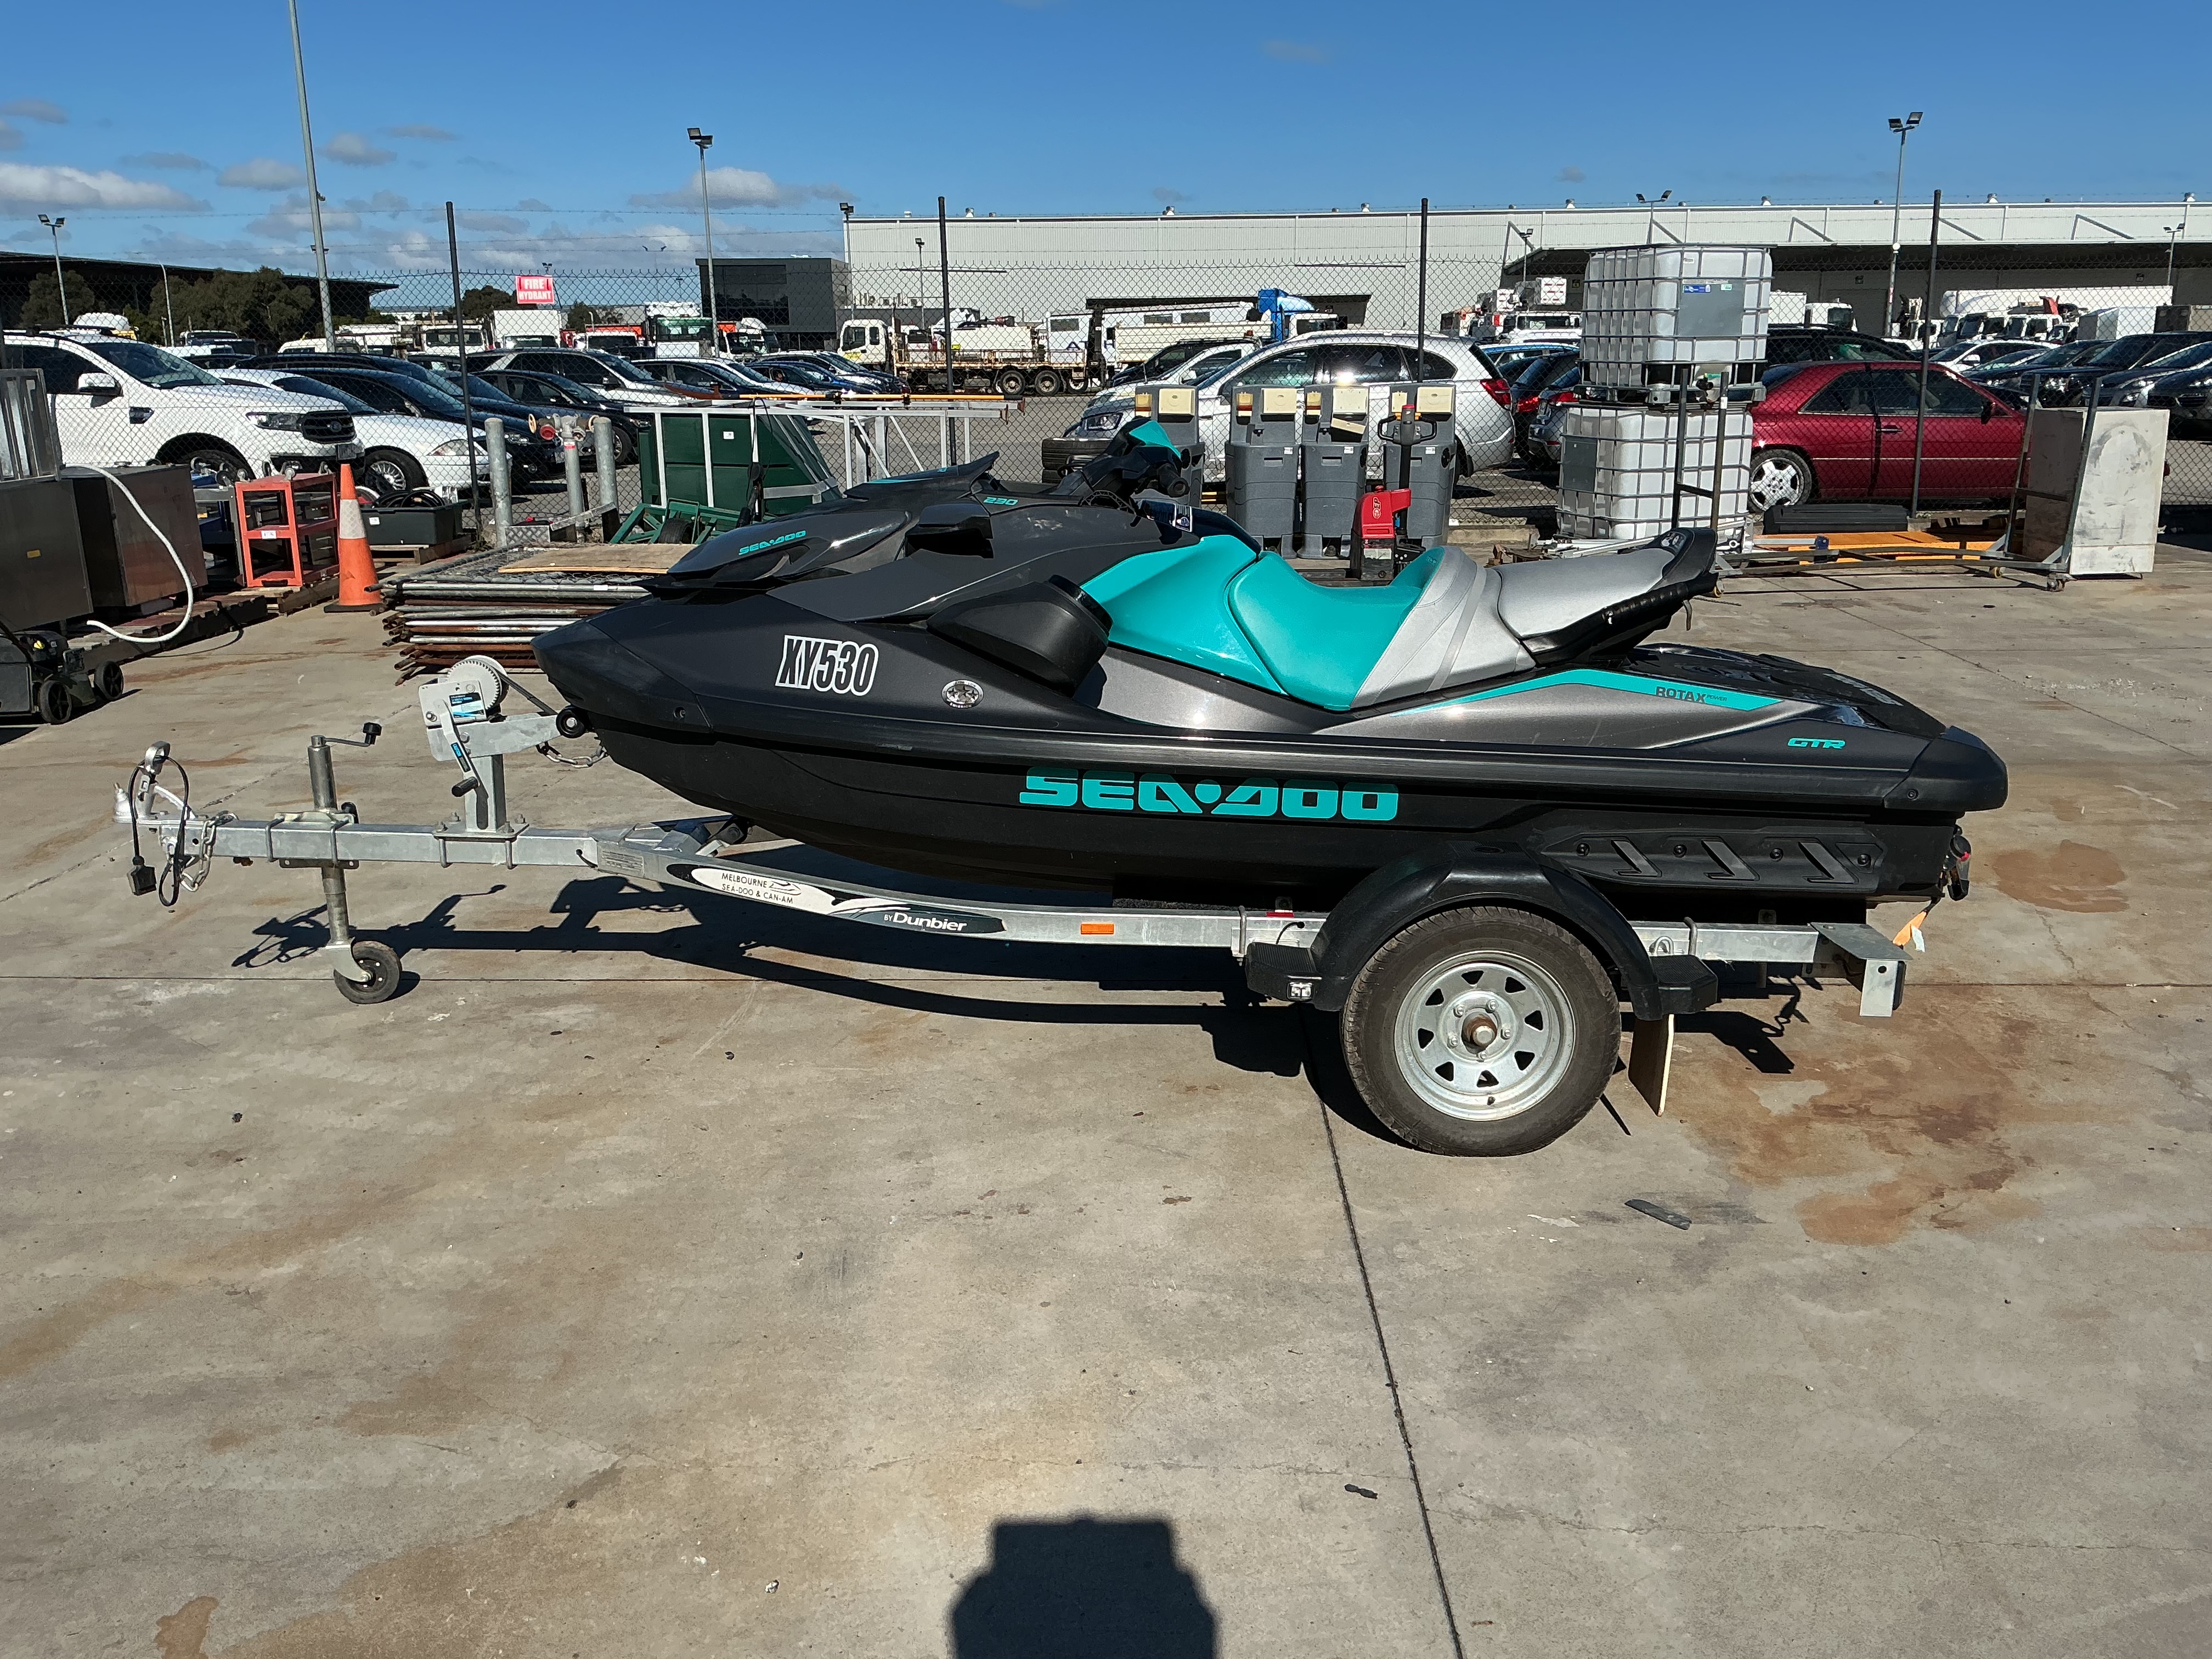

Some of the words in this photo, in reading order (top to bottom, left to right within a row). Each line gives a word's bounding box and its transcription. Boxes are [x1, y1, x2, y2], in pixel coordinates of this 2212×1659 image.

[524, 278, 544, 290] FIRE
[518, 291, 551, 300] HYDRANT
[983, 496, 1018, 506] 230
[775, 635, 878, 696] XY530
[1656, 686, 1706, 703] ROTAX
[1787, 737, 1846, 749] GTR
[721, 872, 767, 888] MELBOURNE
[722, 883, 753, 895] SEA-DOO
[763, 892, 793, 904] CAN-AM
[893, 912, 967, 931] Dunbier
